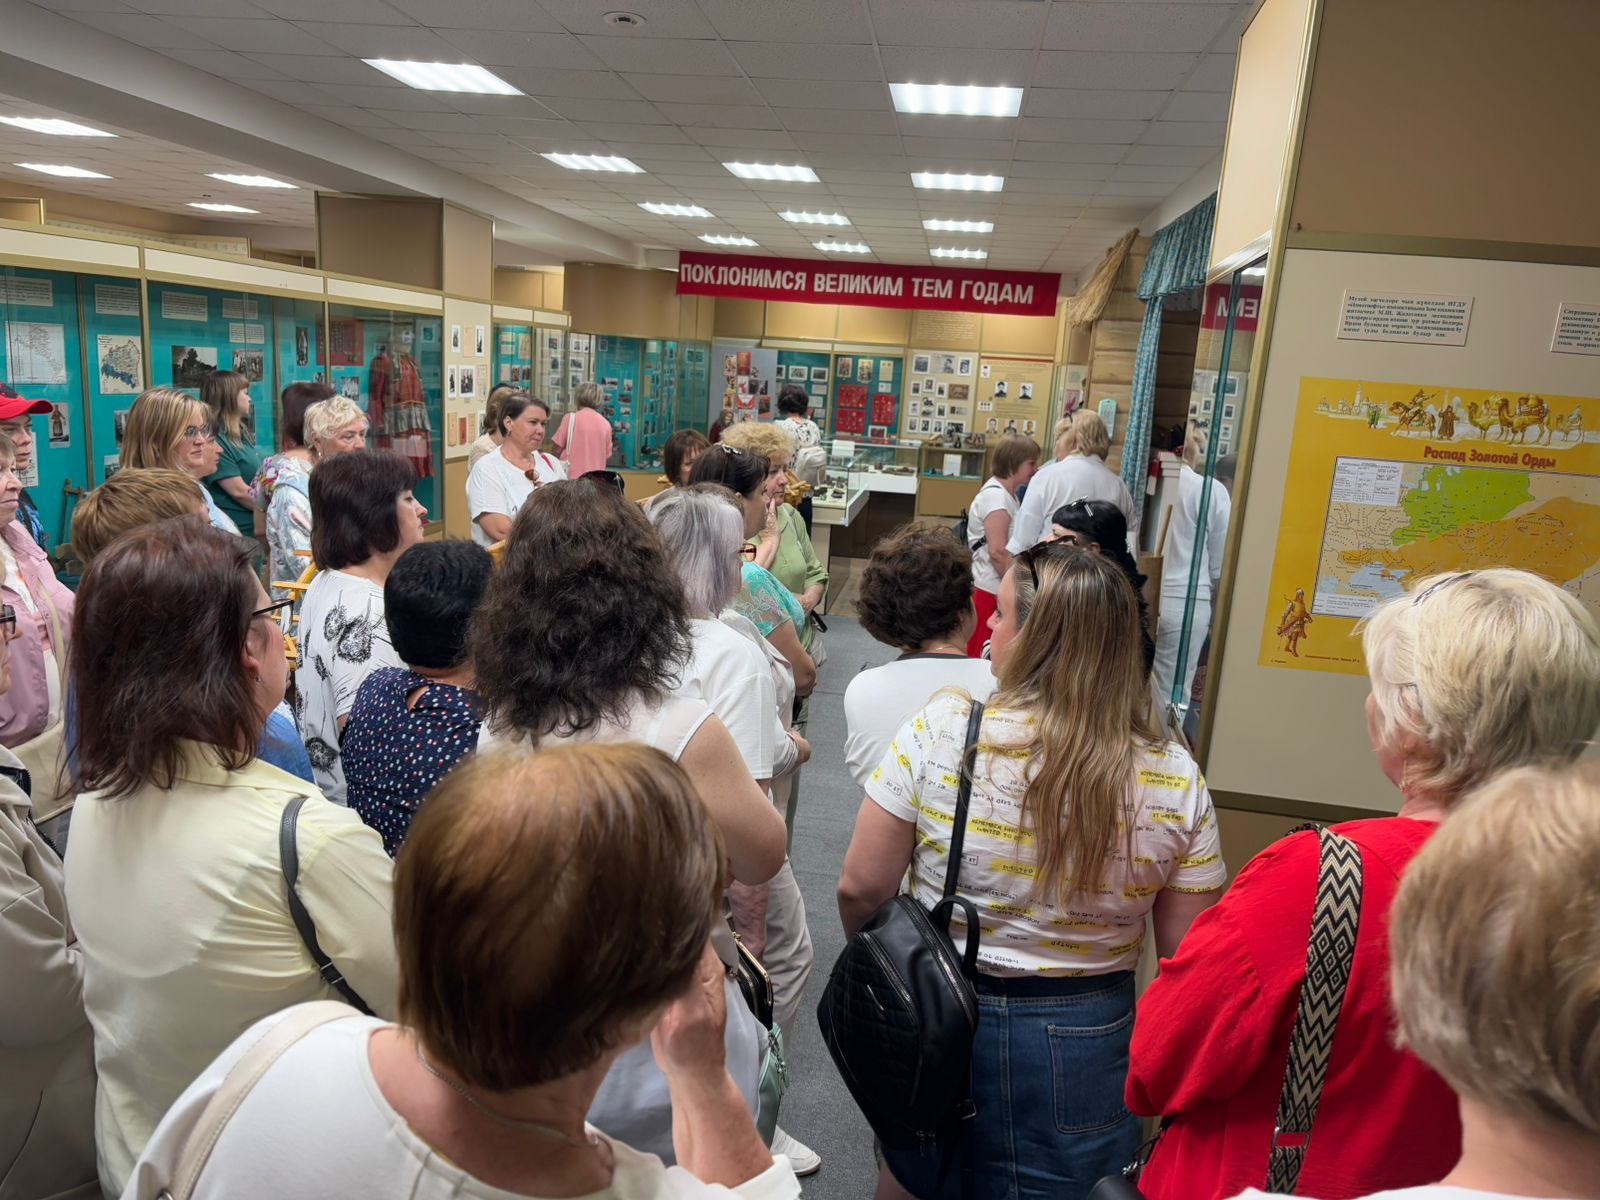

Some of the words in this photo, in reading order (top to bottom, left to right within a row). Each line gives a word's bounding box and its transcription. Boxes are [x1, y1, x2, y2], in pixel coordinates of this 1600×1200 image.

[680, 263, 806, 292] ПОКЛОНИМСЯ
[813, 273, 903, 298] ВЕЛИКИМ
[911, 277, 953, 299] ТЕМ
[960, 280, 1034, 306] ГОДАМ
[1424, 446, 1466, 462] Распад
[1469, 449, 1519, 465] Золотой
[1521, 453, 1556, 468] Орды
